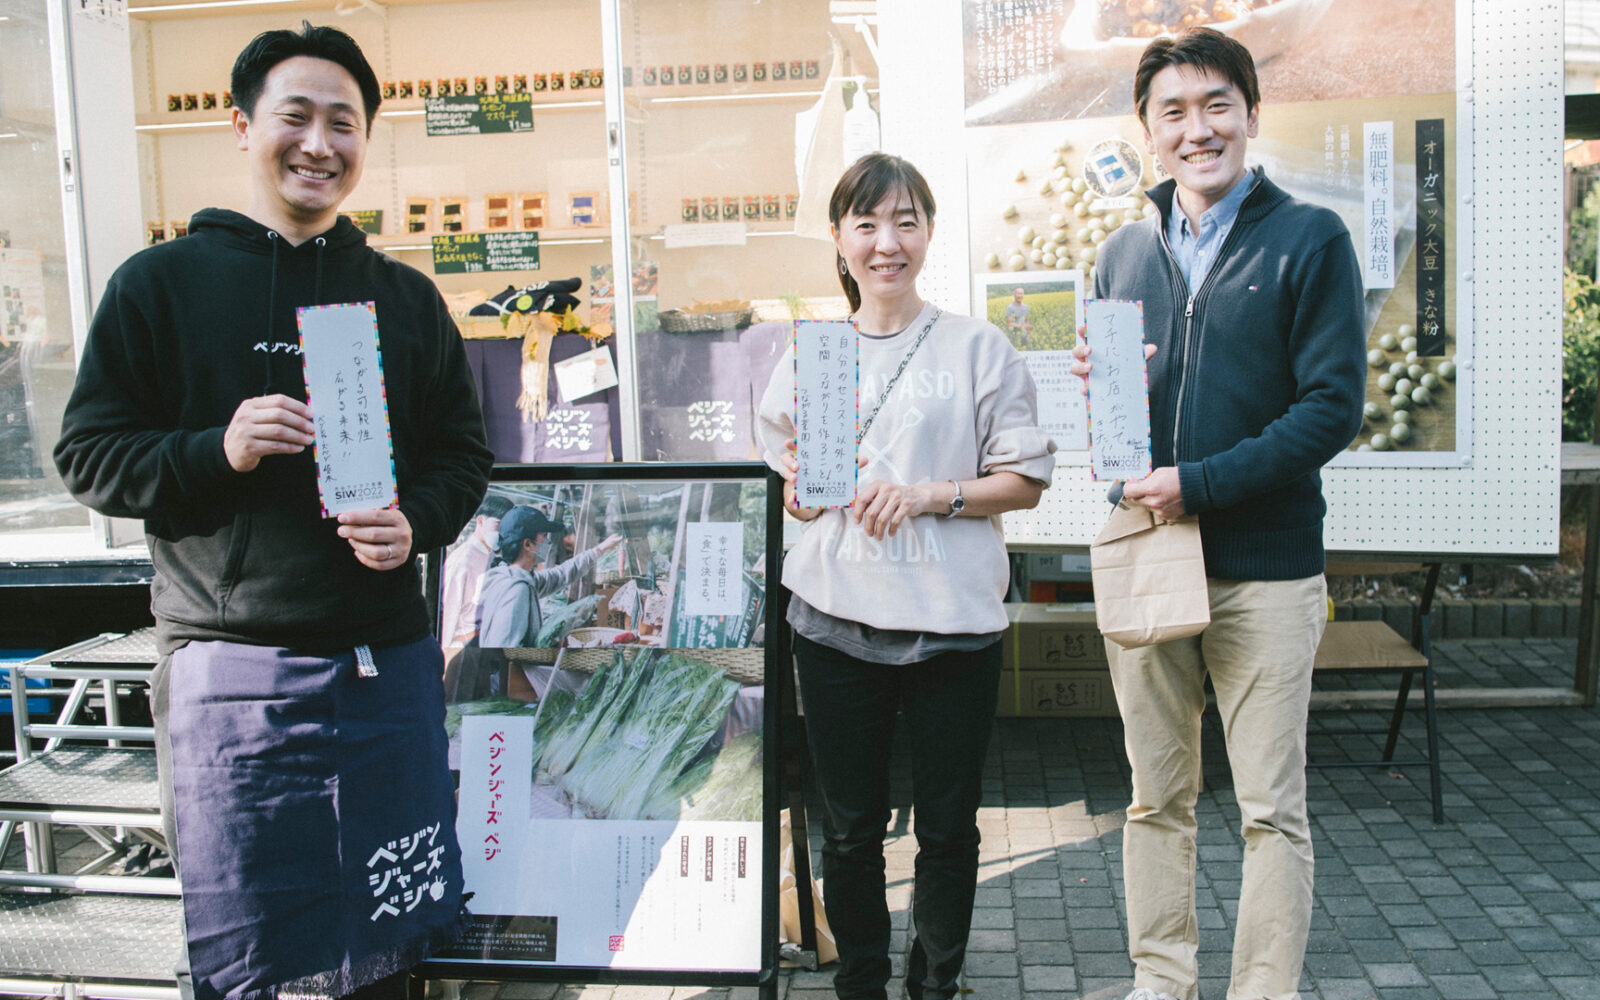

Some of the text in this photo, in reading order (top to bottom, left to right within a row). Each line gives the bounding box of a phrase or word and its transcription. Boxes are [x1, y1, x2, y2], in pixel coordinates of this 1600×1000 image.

[1369, 130, 1389, 280] 無肥料。自然栽培。
[818, 334, 831, 362] 空間
[688, 401, 734, 414] ベジン
[546, 409, 591, 422] ベジン
[546, 422, 593, 437] ジャーズ
[689, 428, 723, 442] ベジ
[545, 435, 580, 450] ベジ
[1102, 459, 1142, 468] SIW2022
[335, 487, 384, 500] SIW2022
[806, 486, 847, 495] SIW2022
[484, 731, 506, 861] ベジンジャーズ ベジ
[366, 821, 441, 868] ベジン
[369, 845, 446, 897] ジャーズ
[370, 881, 430, 922] ベジ
